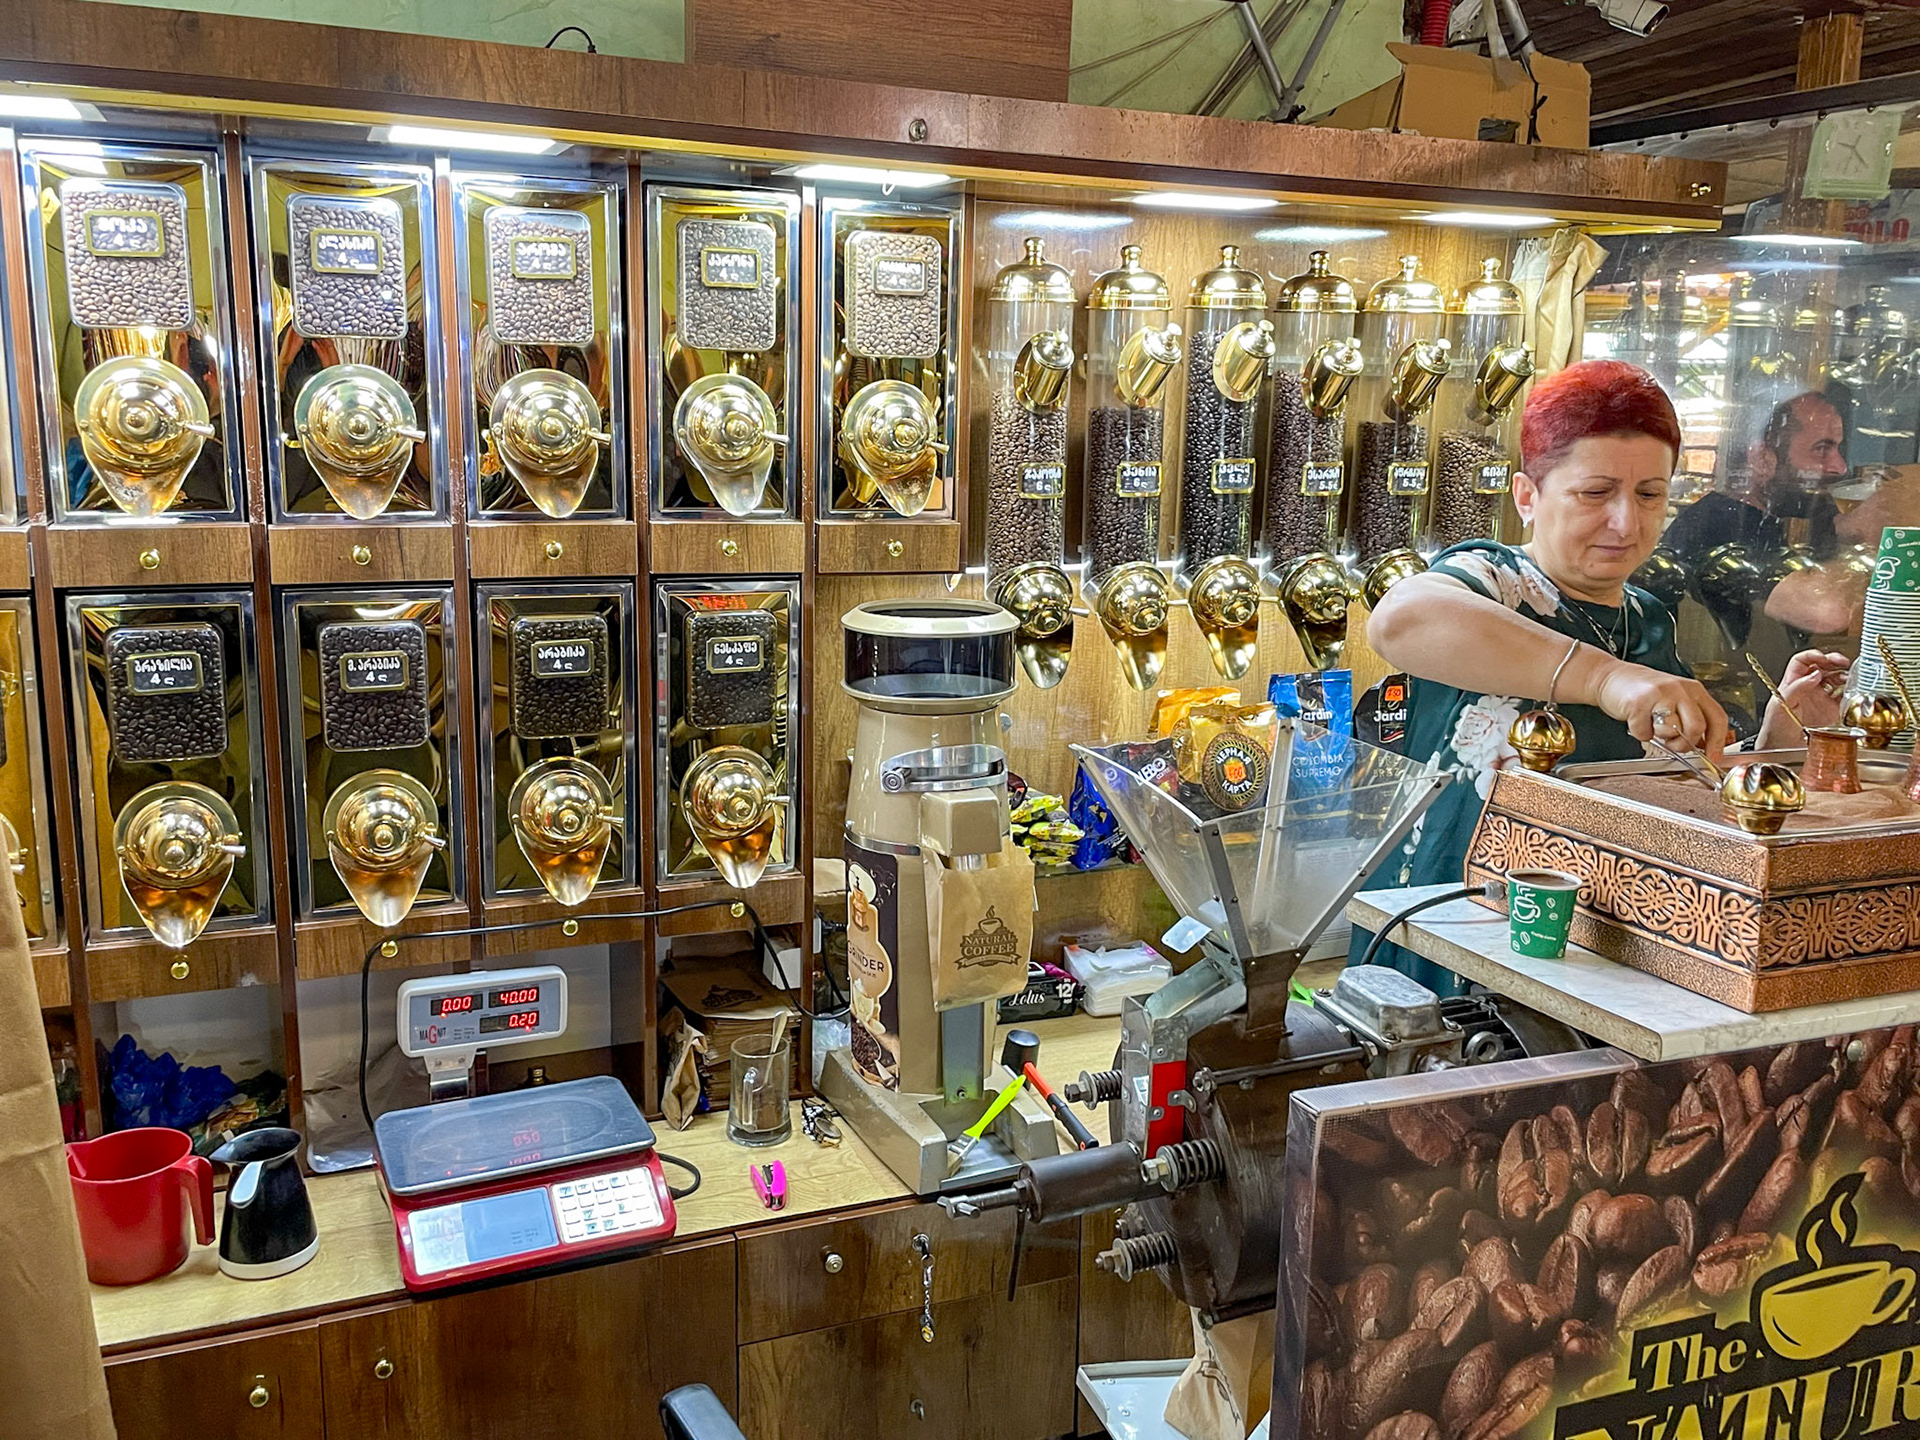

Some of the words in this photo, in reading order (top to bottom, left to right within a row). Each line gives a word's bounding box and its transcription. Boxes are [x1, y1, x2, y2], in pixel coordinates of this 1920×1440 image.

[113, 233, 124, 246] 4
[338, 252, 348, 264] 4
[532, 257, 541, 269] 4
[719, 268, 728, 279] 4
[538, 645, 585, 659] არაბიკა
[714, 641, 757, 654] ნესკაფე
[134, 658, 193, 673] ბრაზილია
[552, 659, 562, 670] 4
[725, 655, 733, 665] 4
[150, 673, 161, 685] 4
[365, 671, 375, 682] 4
[1296, 709, 1333, 721] Jardin
[1373, 708, 1407, 722] Jardi
[1215, 747, 1252, 765] ЧЕРНАЯ
[1295, 766, 1341, 778] SUPREMO
[1221, 780, 1252, 794] КАРТА
[965, 933, 1014, 945] NATURAL
[964, 943, 1014, 956] COFFEE
[500, 988, 537, 1004] 40.00
[442, 996, 472, 1012] 0.00
[509, 1012, 537, 1027] 0.20
[419, 1025, 446, 1044] MAGNIT
[1640, 1333, 1748, 1393] The
